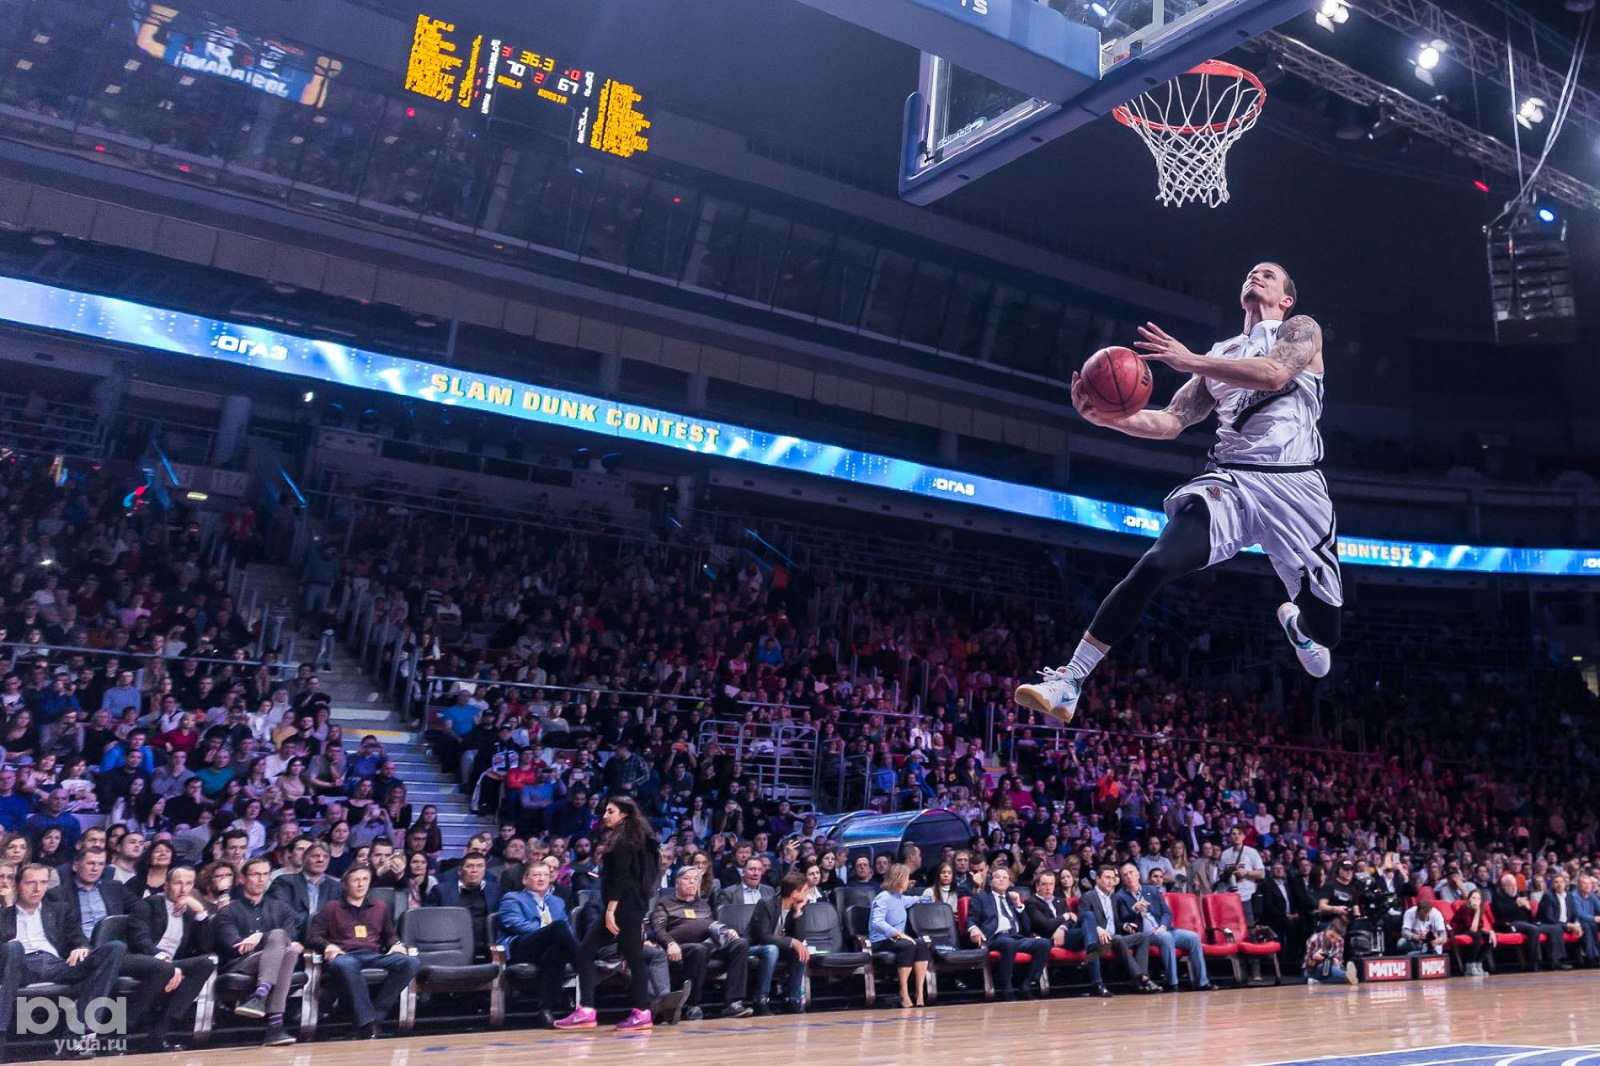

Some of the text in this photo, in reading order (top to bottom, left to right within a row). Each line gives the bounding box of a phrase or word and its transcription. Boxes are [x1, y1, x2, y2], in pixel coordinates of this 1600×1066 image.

[506, 60, 526, 77] 70
[520, 51, 555, 72] 36.3
[534, 72, 545, 84] 2
[557, 78, 579, 94] 67
[537, 88, 568, 104] RUSSIA
[431, 374, 720, 444] SLAM DUNK CONTEST
[1337, 542, 1412, 562] CONTEST
